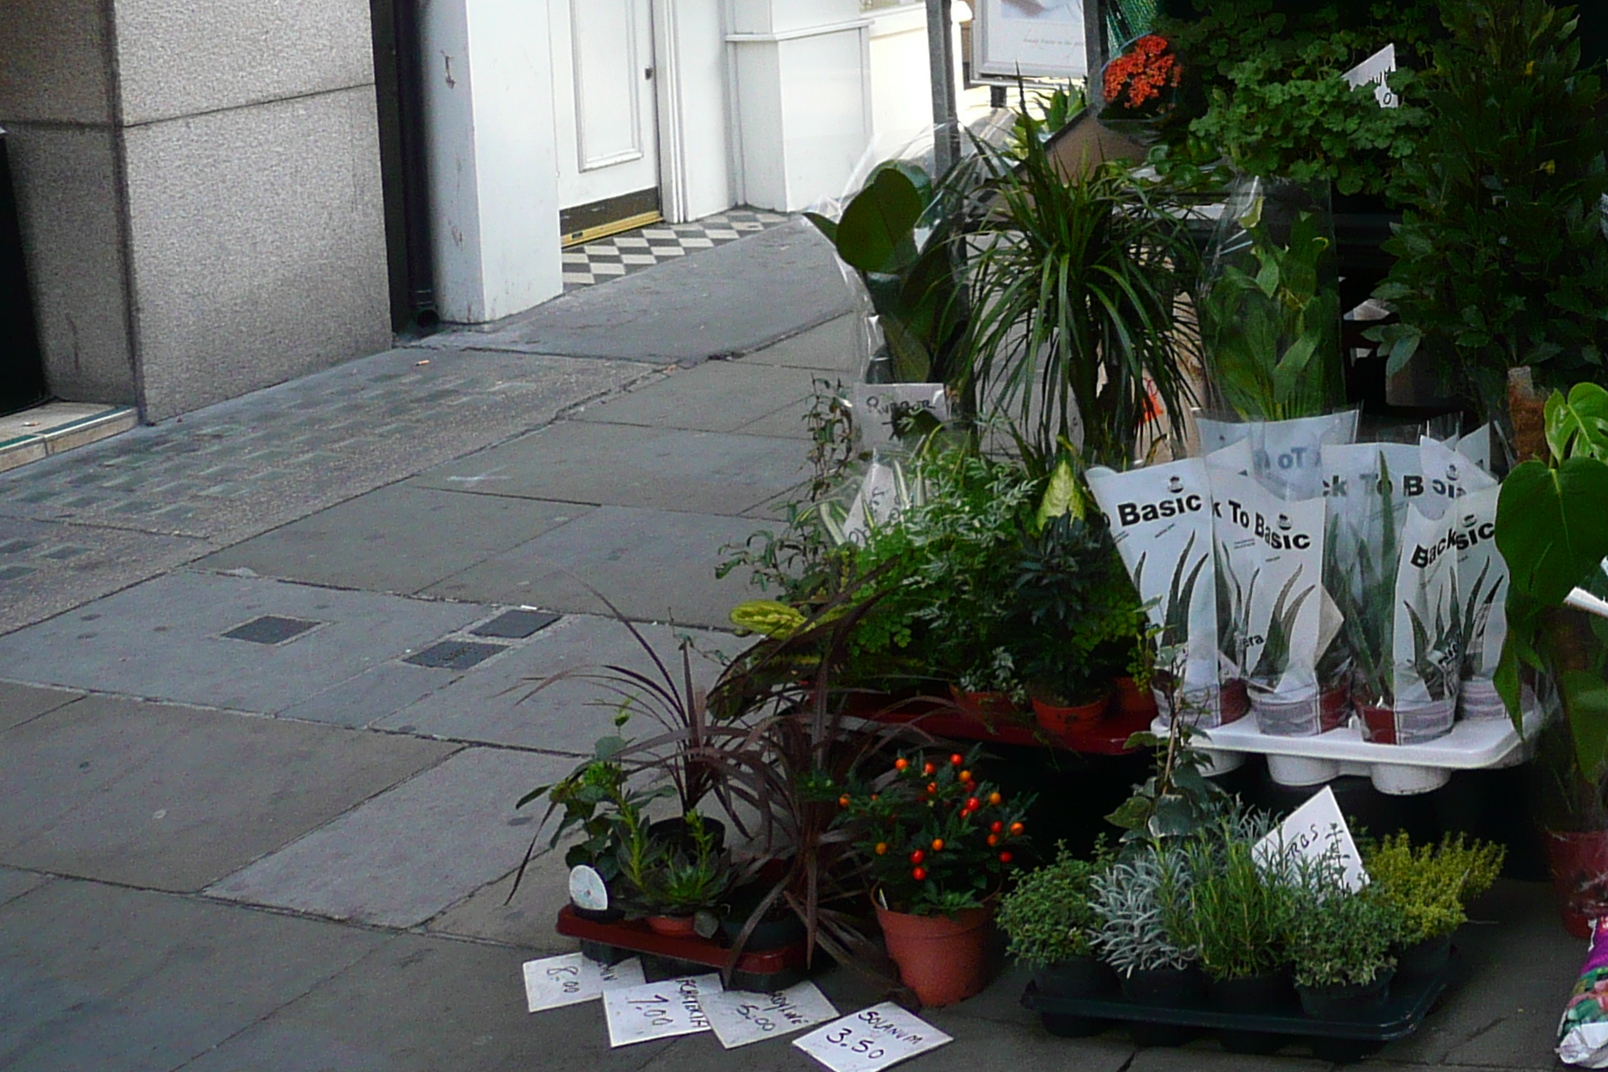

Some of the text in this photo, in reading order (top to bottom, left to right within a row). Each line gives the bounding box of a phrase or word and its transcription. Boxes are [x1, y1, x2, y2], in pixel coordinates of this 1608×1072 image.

[1117, 493, 1202, 527] Basic
[1228, 500, 1250, 529] To
[826, 1028, 884, 1060] 3.50
[858, 1011, 922, 1045] SOLANUM
